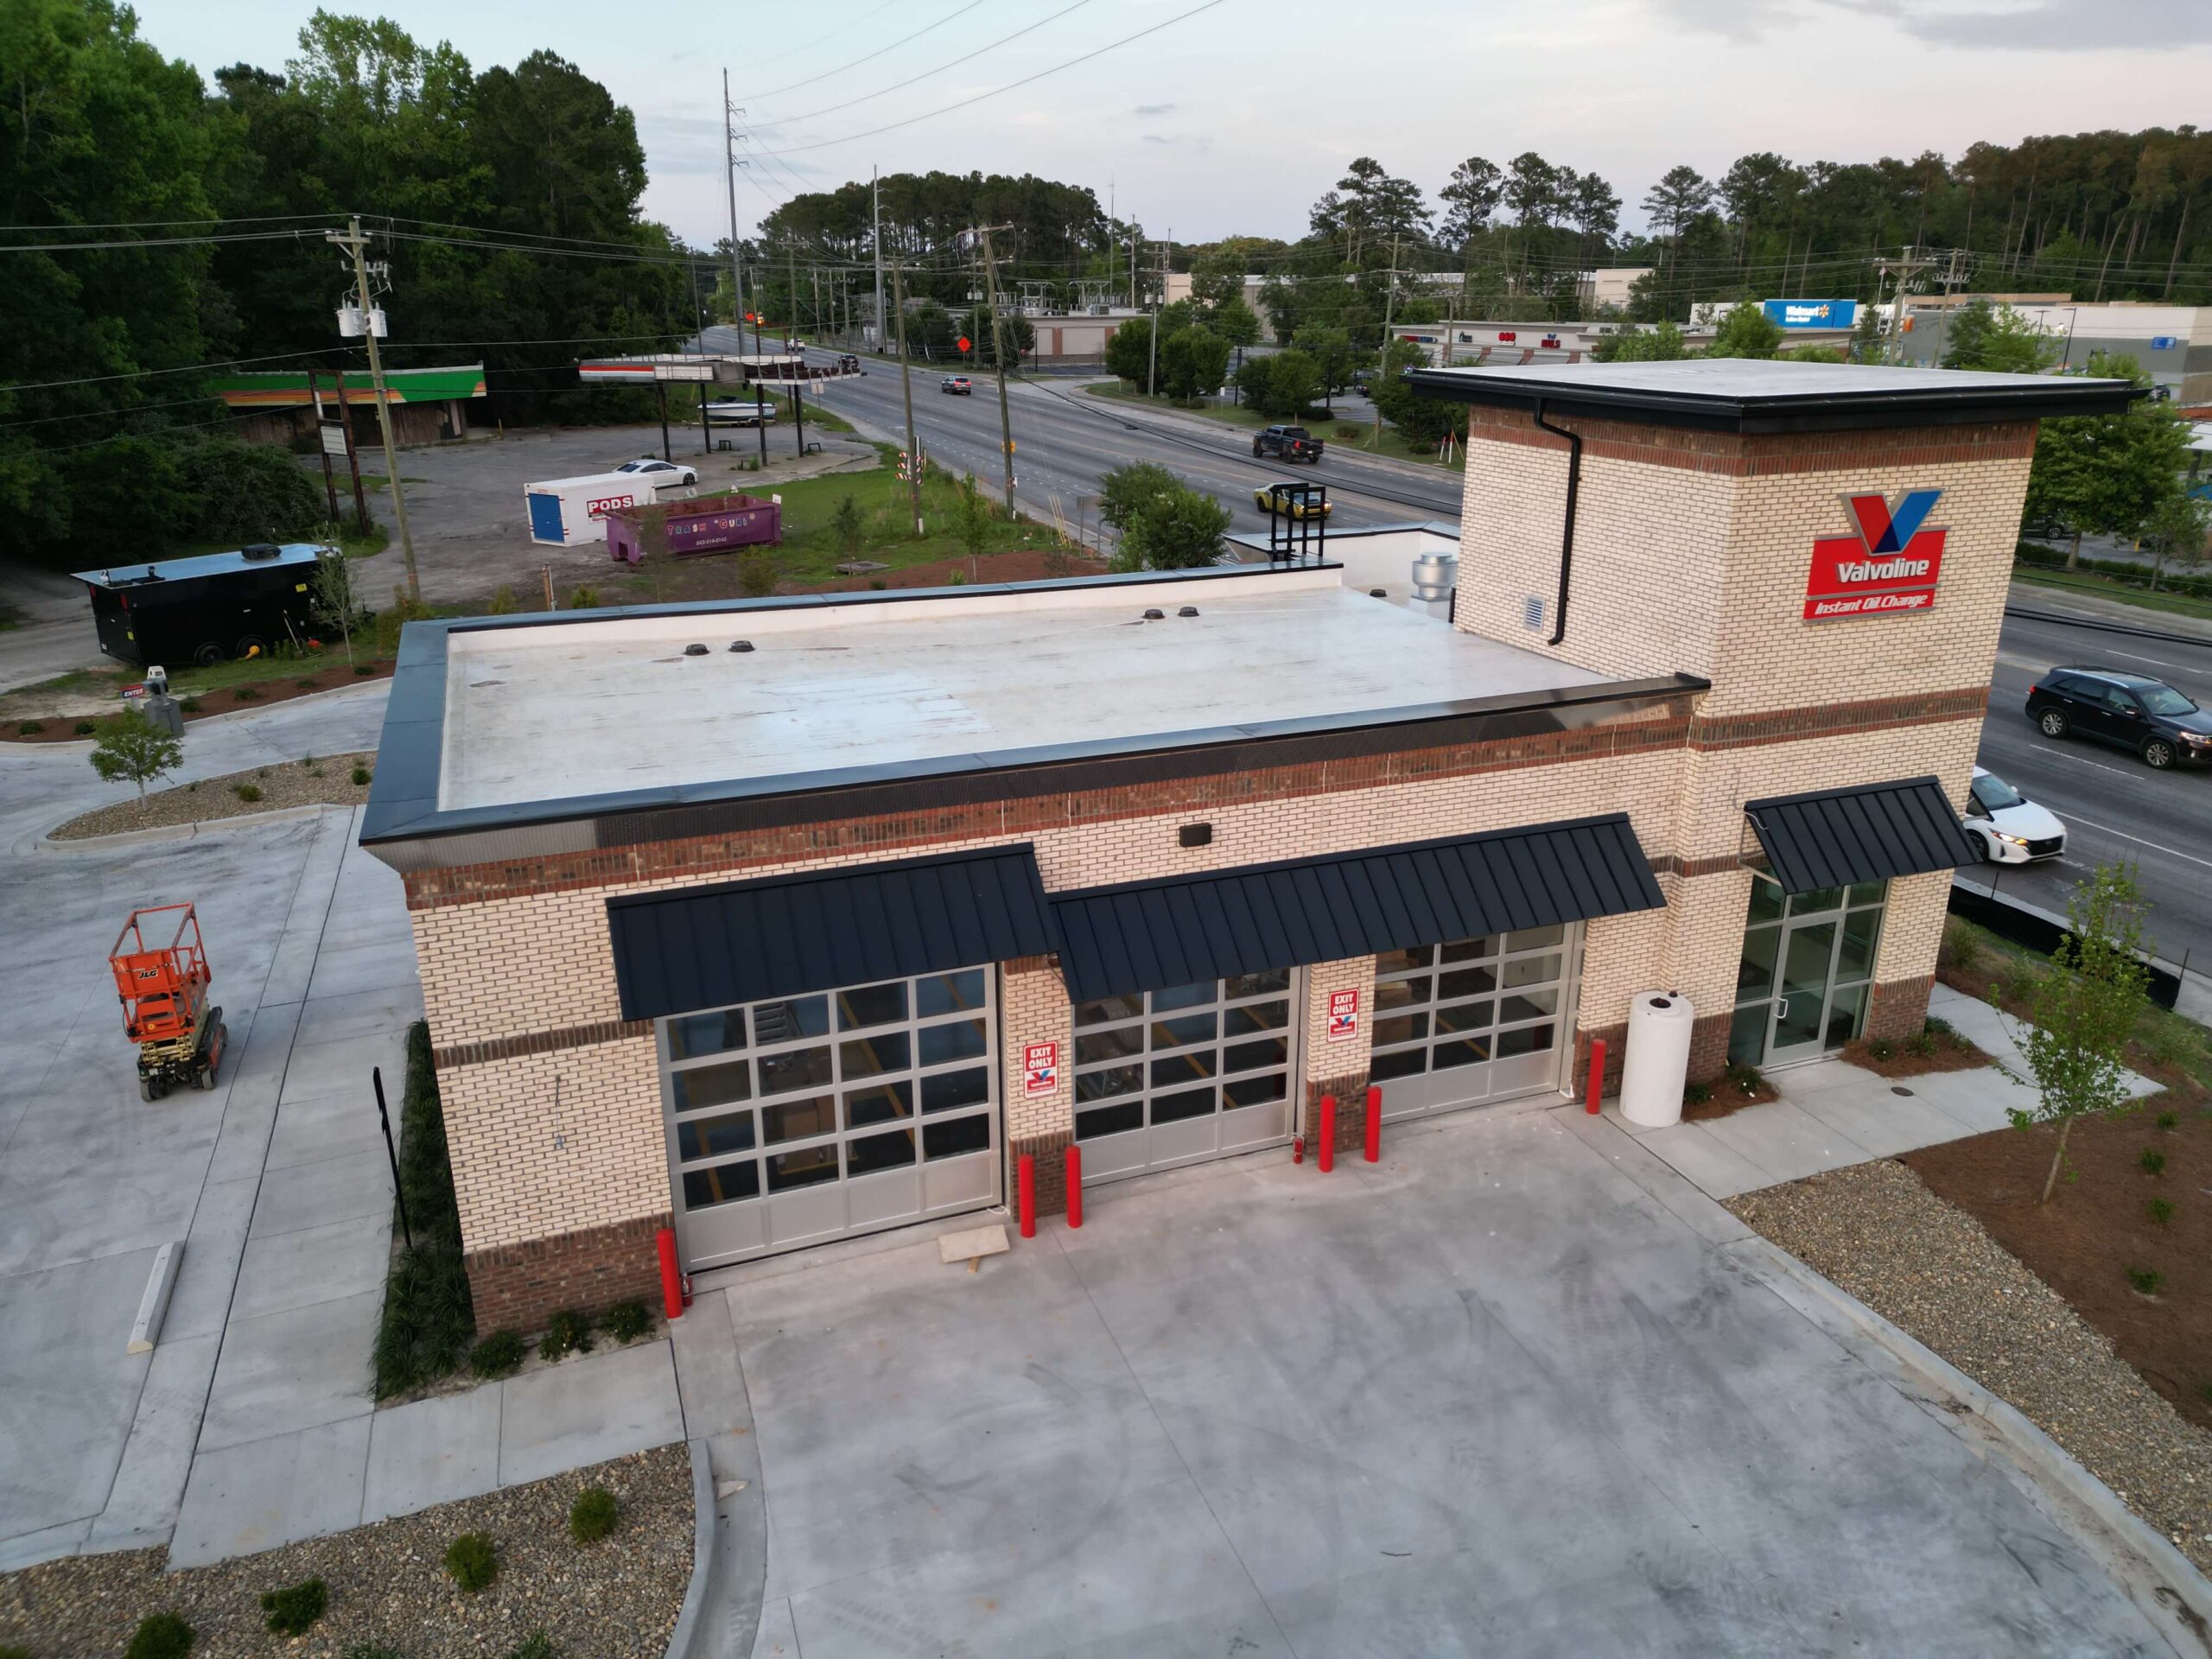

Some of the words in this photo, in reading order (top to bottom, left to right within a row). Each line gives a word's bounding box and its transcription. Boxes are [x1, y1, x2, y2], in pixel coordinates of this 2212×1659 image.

[588, 497, 632, 513] PODS
[667, 522, 707, 536] TRASH
[1838, 557, 1930, 583] Valvoline
[1815, 599, 1863, 615] Instant
[1861, 596, 1882, 610] Oil
[1880, 594, 1929, 607] Change
[138, 969, 157, 979] JLG
[1334, 993, 1354, 1005] EXIT
[1332, 1002, 1355, 1015] ONLY
[1030, 1046, 1052, 1059] EXIT
[1028, 1056, 1053, 1070] ONLY
